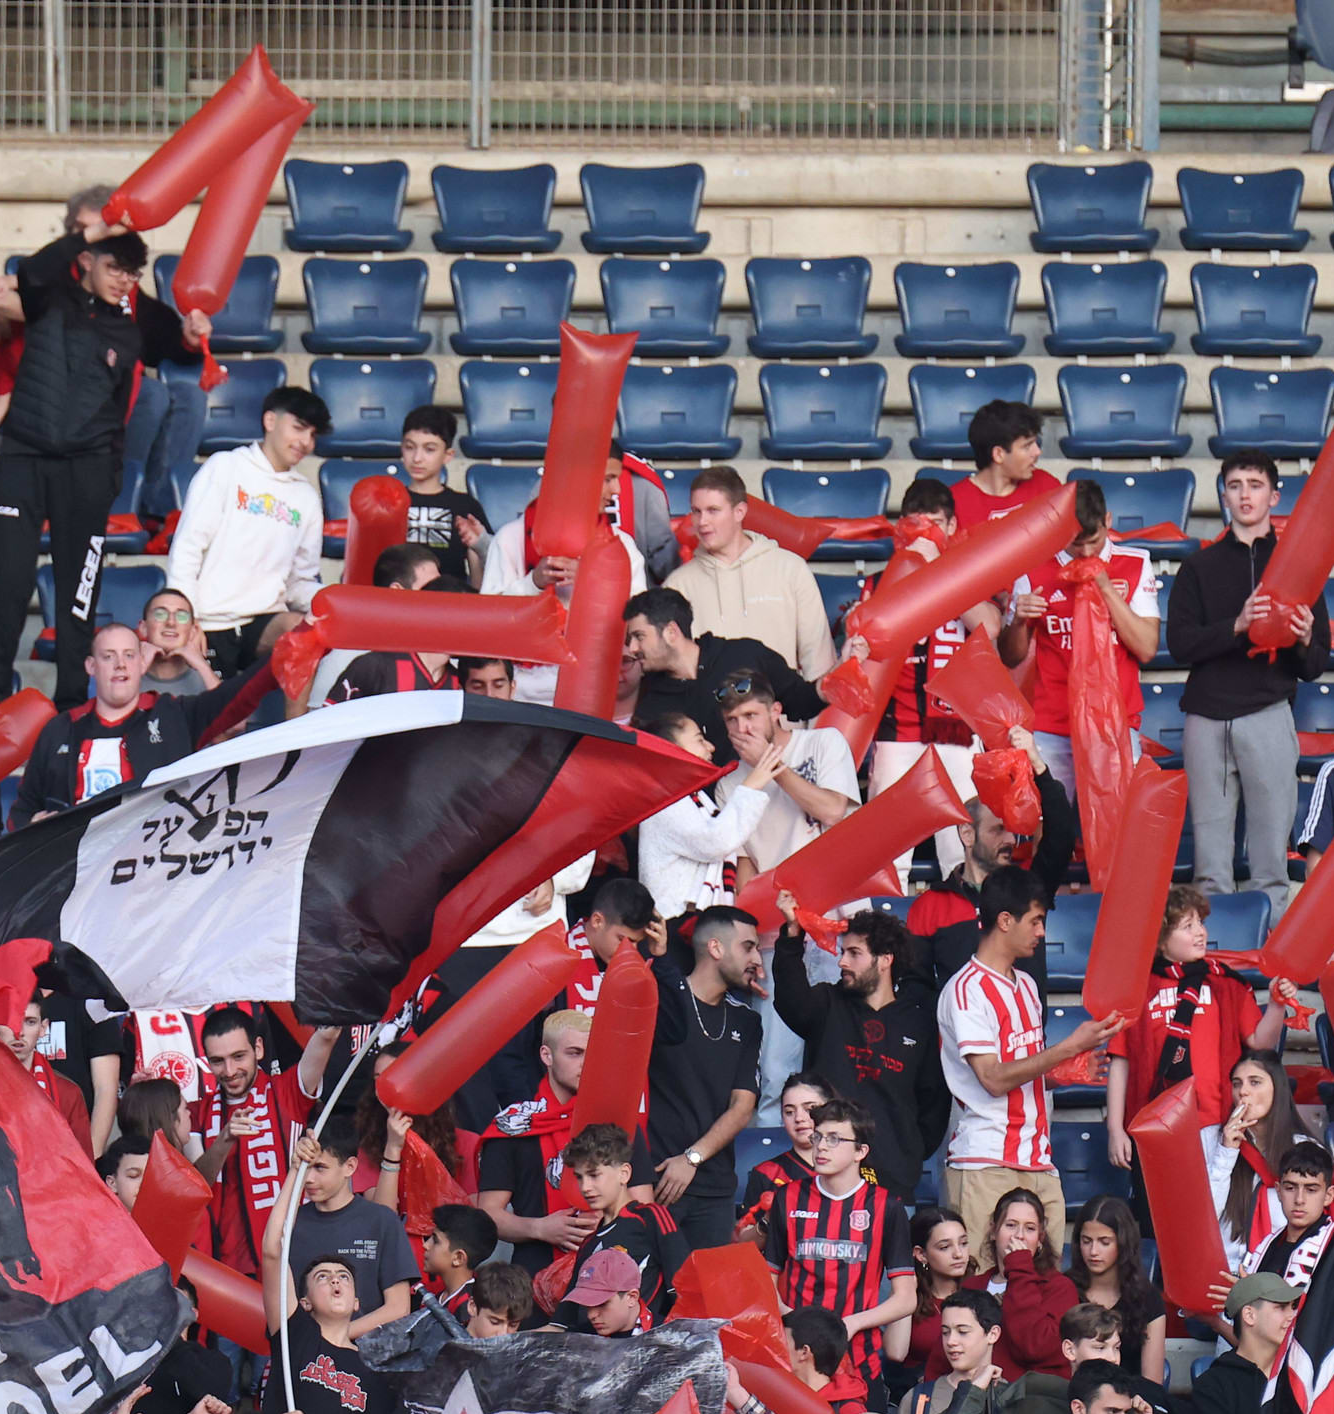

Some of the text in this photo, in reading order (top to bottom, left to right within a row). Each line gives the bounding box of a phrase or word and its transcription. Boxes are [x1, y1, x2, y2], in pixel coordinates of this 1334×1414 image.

[72, 535, 107, 622] LEGEA
[109, 834, 273, 886] ירושלים
[1148, 984, 1212, 1012] PUA
